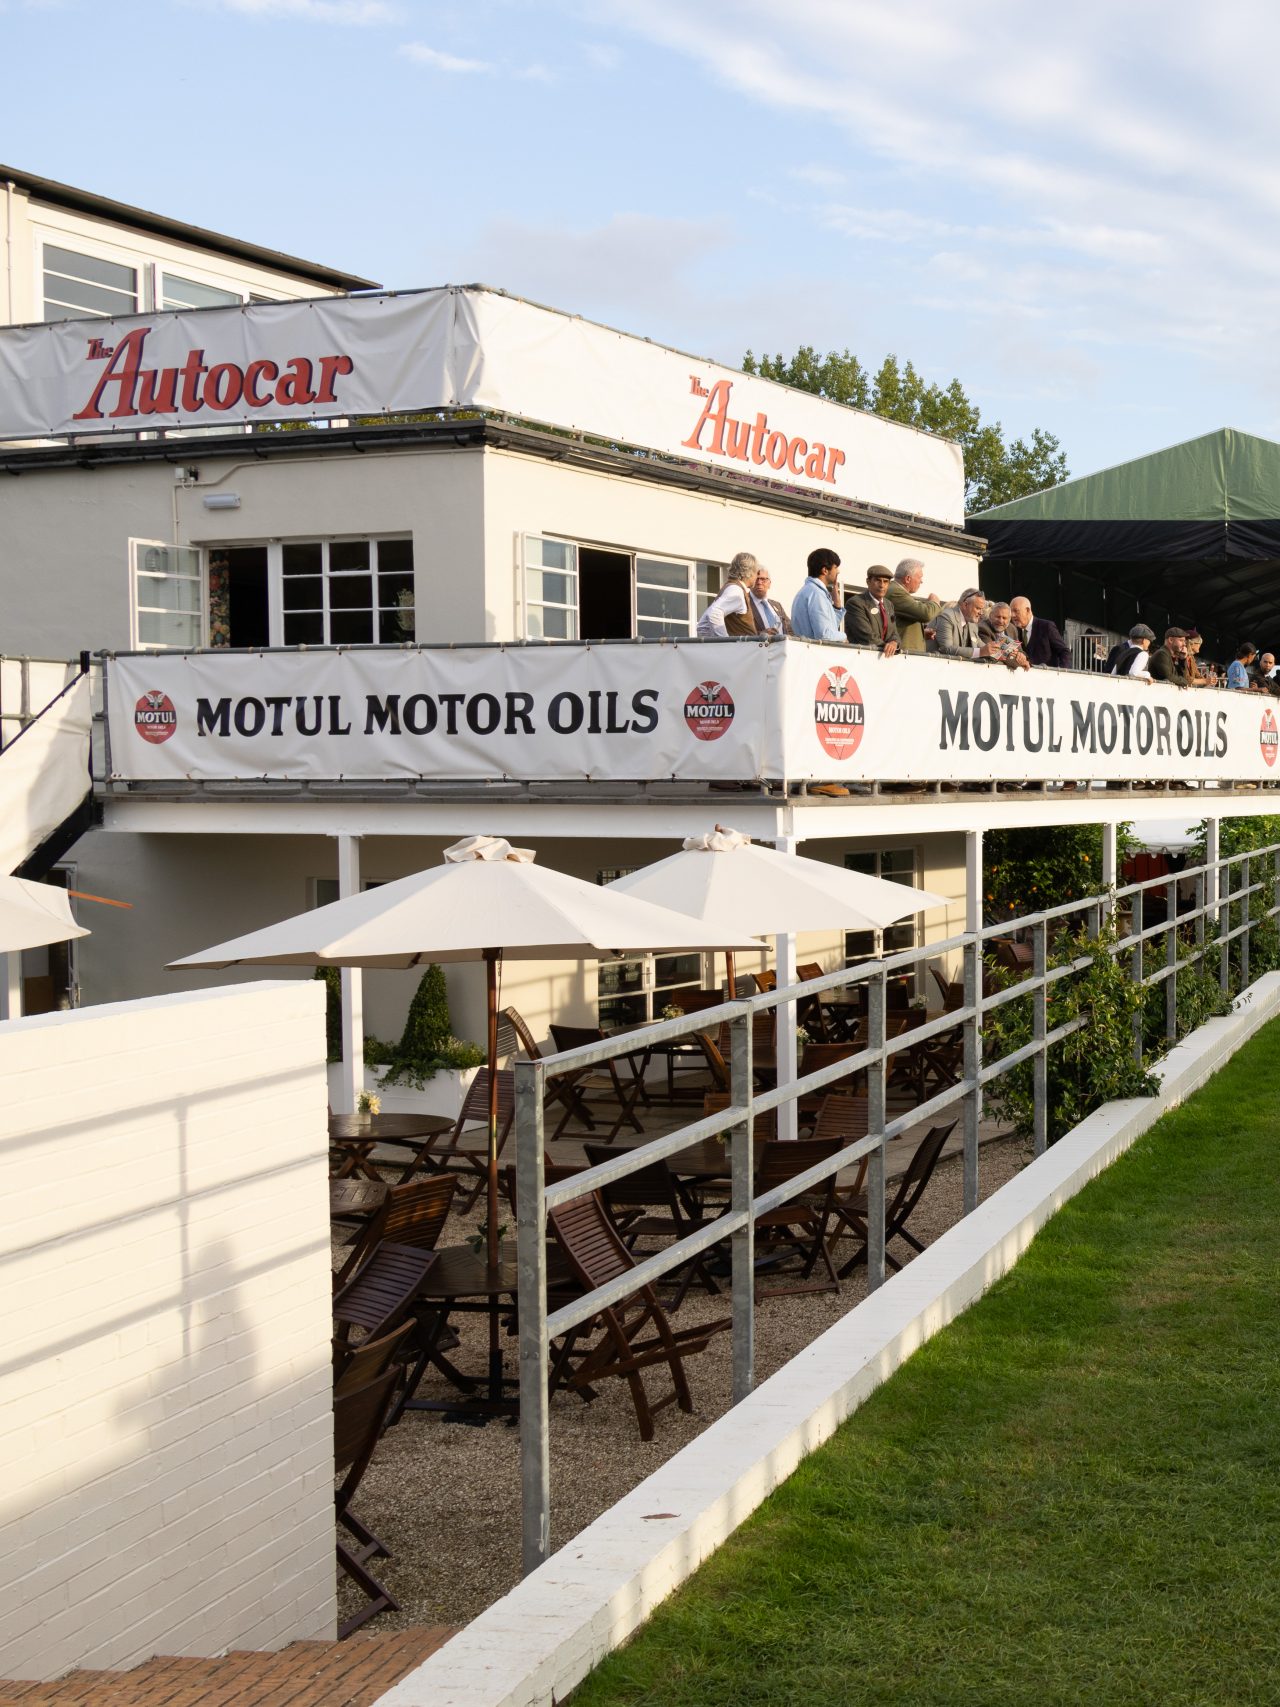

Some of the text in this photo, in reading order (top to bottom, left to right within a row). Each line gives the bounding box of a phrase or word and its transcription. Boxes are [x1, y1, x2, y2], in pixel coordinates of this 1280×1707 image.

[73, 327, 354, 420] The Autocar
[681, 375, 846, 485] The Autocar
[137, 711, 175, 723] MOTUL
[196, 689, 660, 737] MOTUL MOTOR OILS
[687, 705, 733, 718] MOTUL
[816, 702, 863, 724] MOTUL
[938, 689, 1228, 758] MOTUL MOTOR OILS
[1261, 731, 1278, 744] MOTUL
